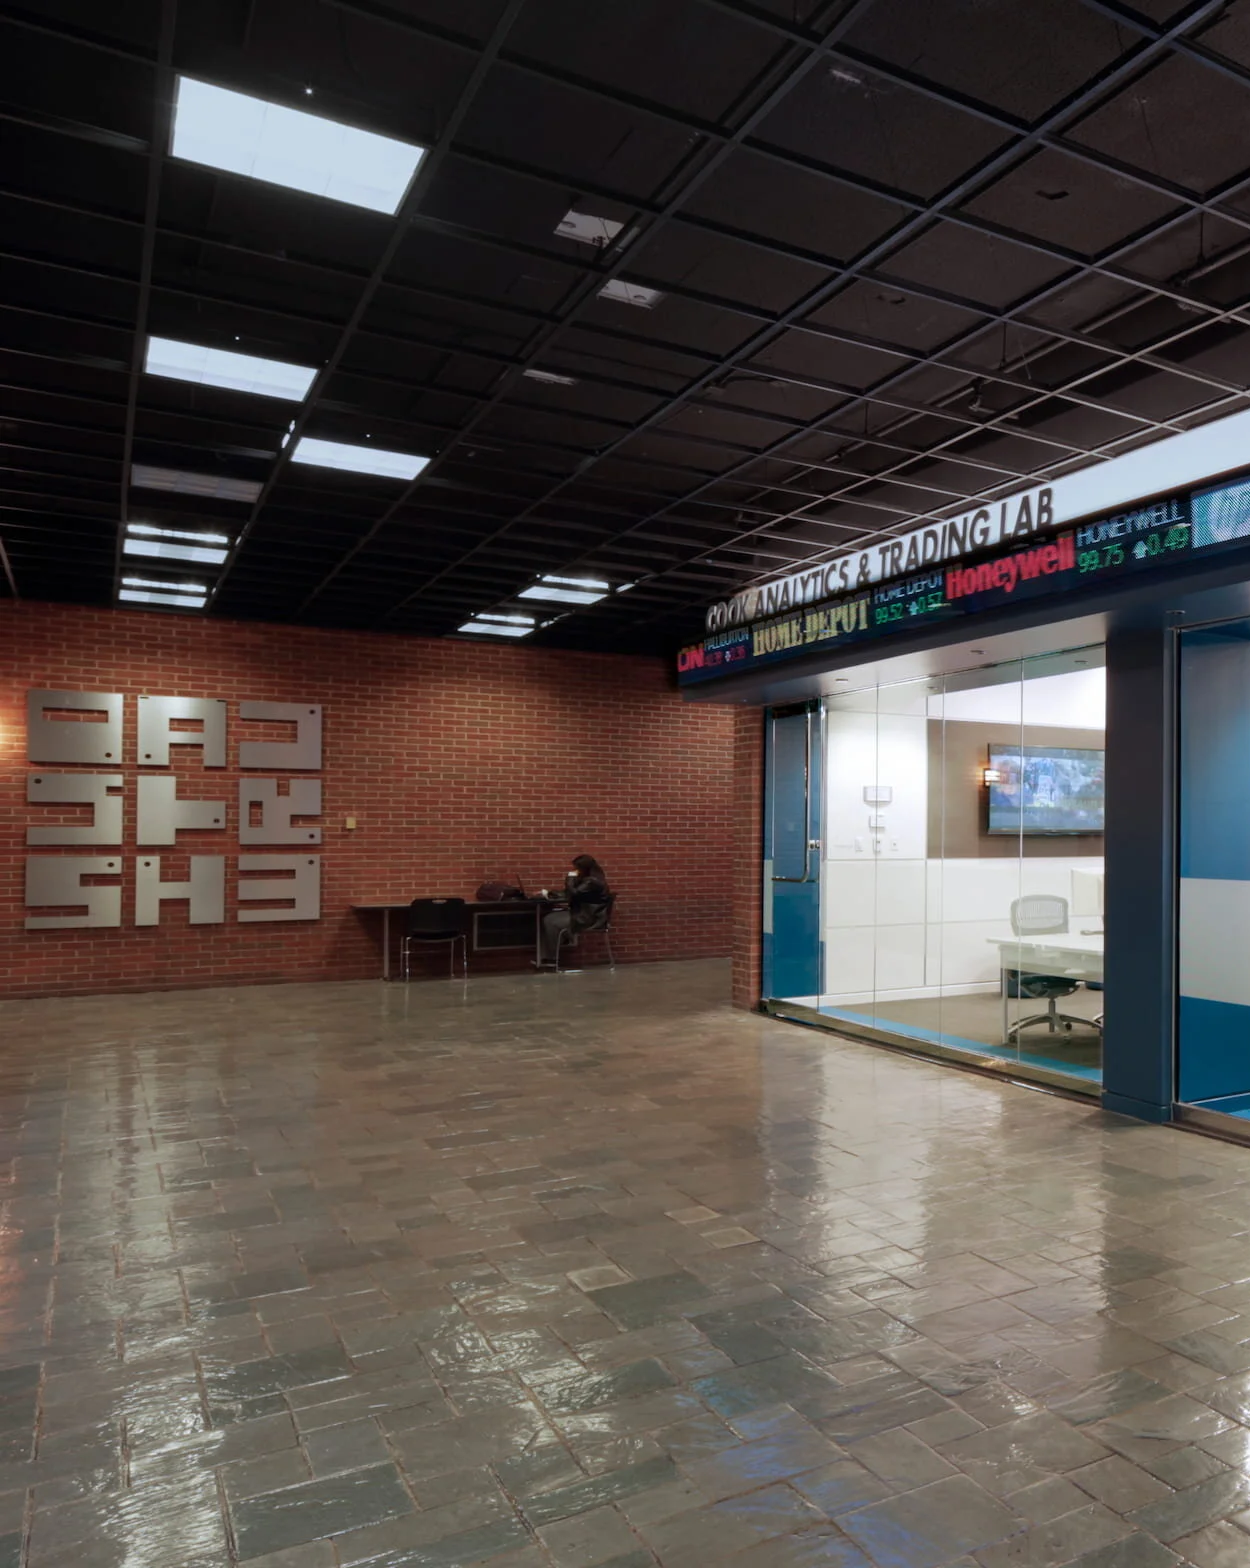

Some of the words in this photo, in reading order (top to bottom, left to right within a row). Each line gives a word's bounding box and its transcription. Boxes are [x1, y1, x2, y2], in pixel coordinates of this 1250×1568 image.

[705, 595, 751, 632] COOK
[755, 560, 848, 618] ANALYTICS
[857, 553, 871, 587] &
[879, 509, 990, 580] TRADING
[1000, 486, 1055, 540] LAB
[946, 531, 1075, 600] Honeywell
[1077, 543, 1125, 573] 99.75
[752, 617, 803, 657] HOME
[804, 593, 870, 644] DEPOT
[875, 602, 904, 625] 99.52
